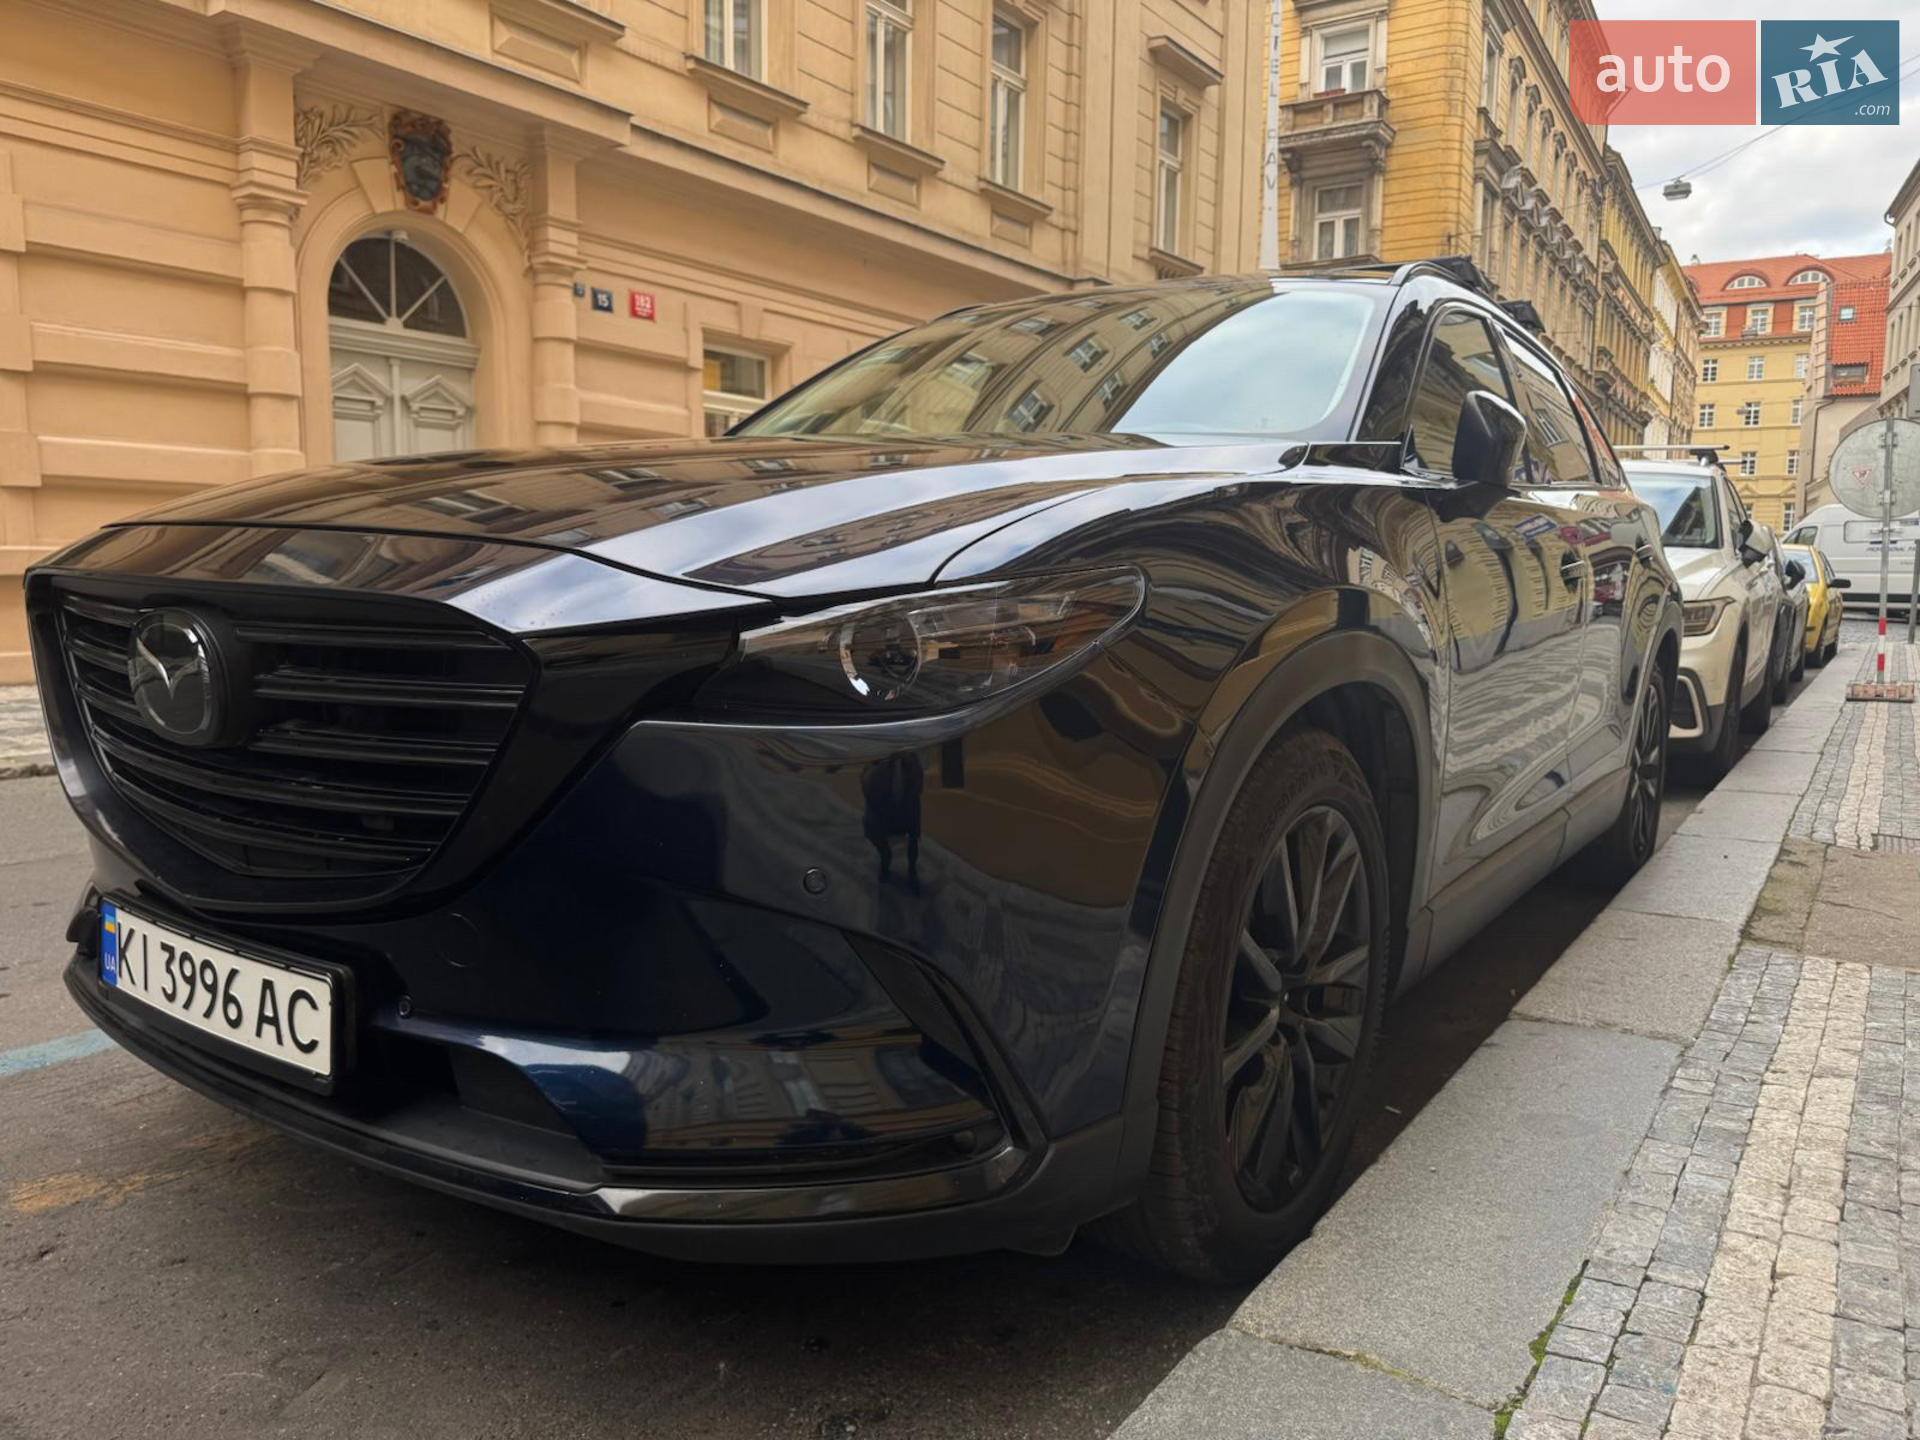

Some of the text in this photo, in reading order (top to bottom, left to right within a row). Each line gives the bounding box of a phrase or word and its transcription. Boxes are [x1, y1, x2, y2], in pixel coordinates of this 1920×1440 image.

[597, 293, 609, 308] 15
[104, 951, 116, 973] UA
[117, 921, 320, 1054] KI 3996 AC
